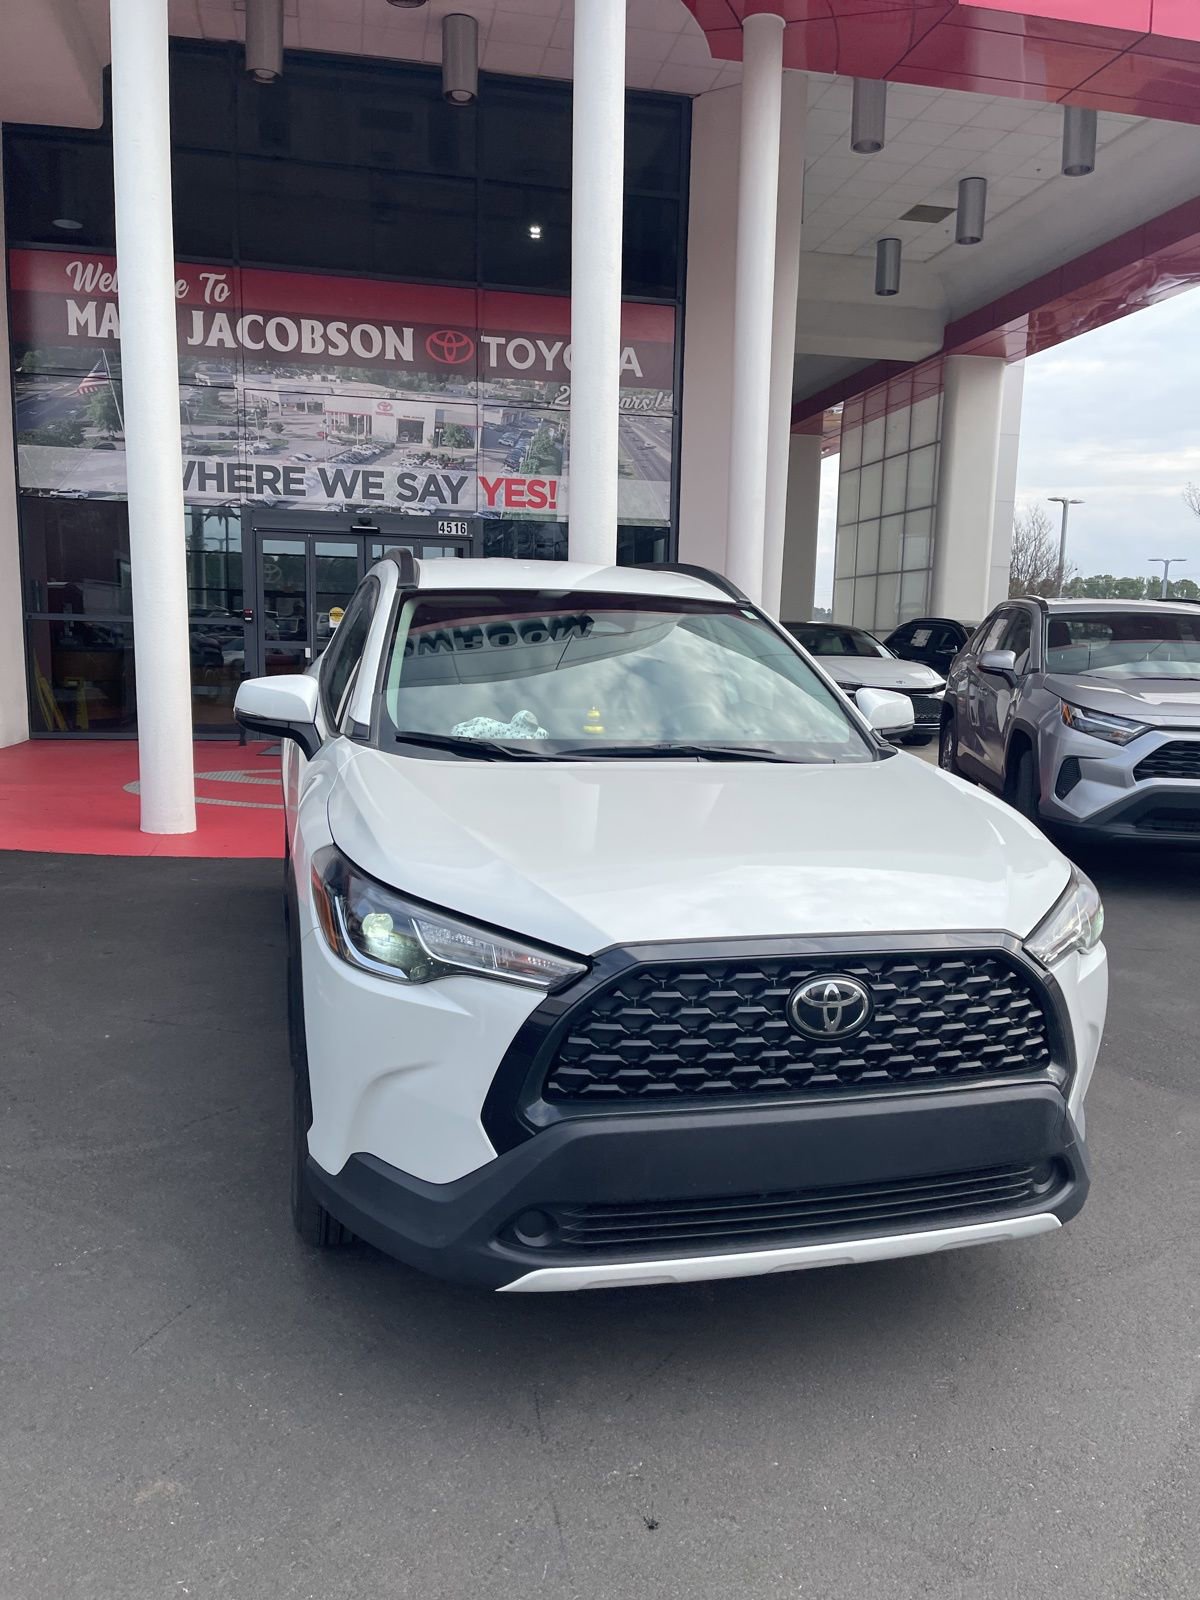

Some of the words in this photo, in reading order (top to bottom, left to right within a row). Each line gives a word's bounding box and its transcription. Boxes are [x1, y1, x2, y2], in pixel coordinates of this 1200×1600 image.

[199, 272, 231, 304] To
[187, 309, 414, 362] JACOBSON
[480, 335, 643, 378] TOYA
[317, 466, 385, 500] WE
[396, 472, 469, 504] SAY
[478, 476, 557, 509] YES!
[438, 521, 467, 534] 4516
